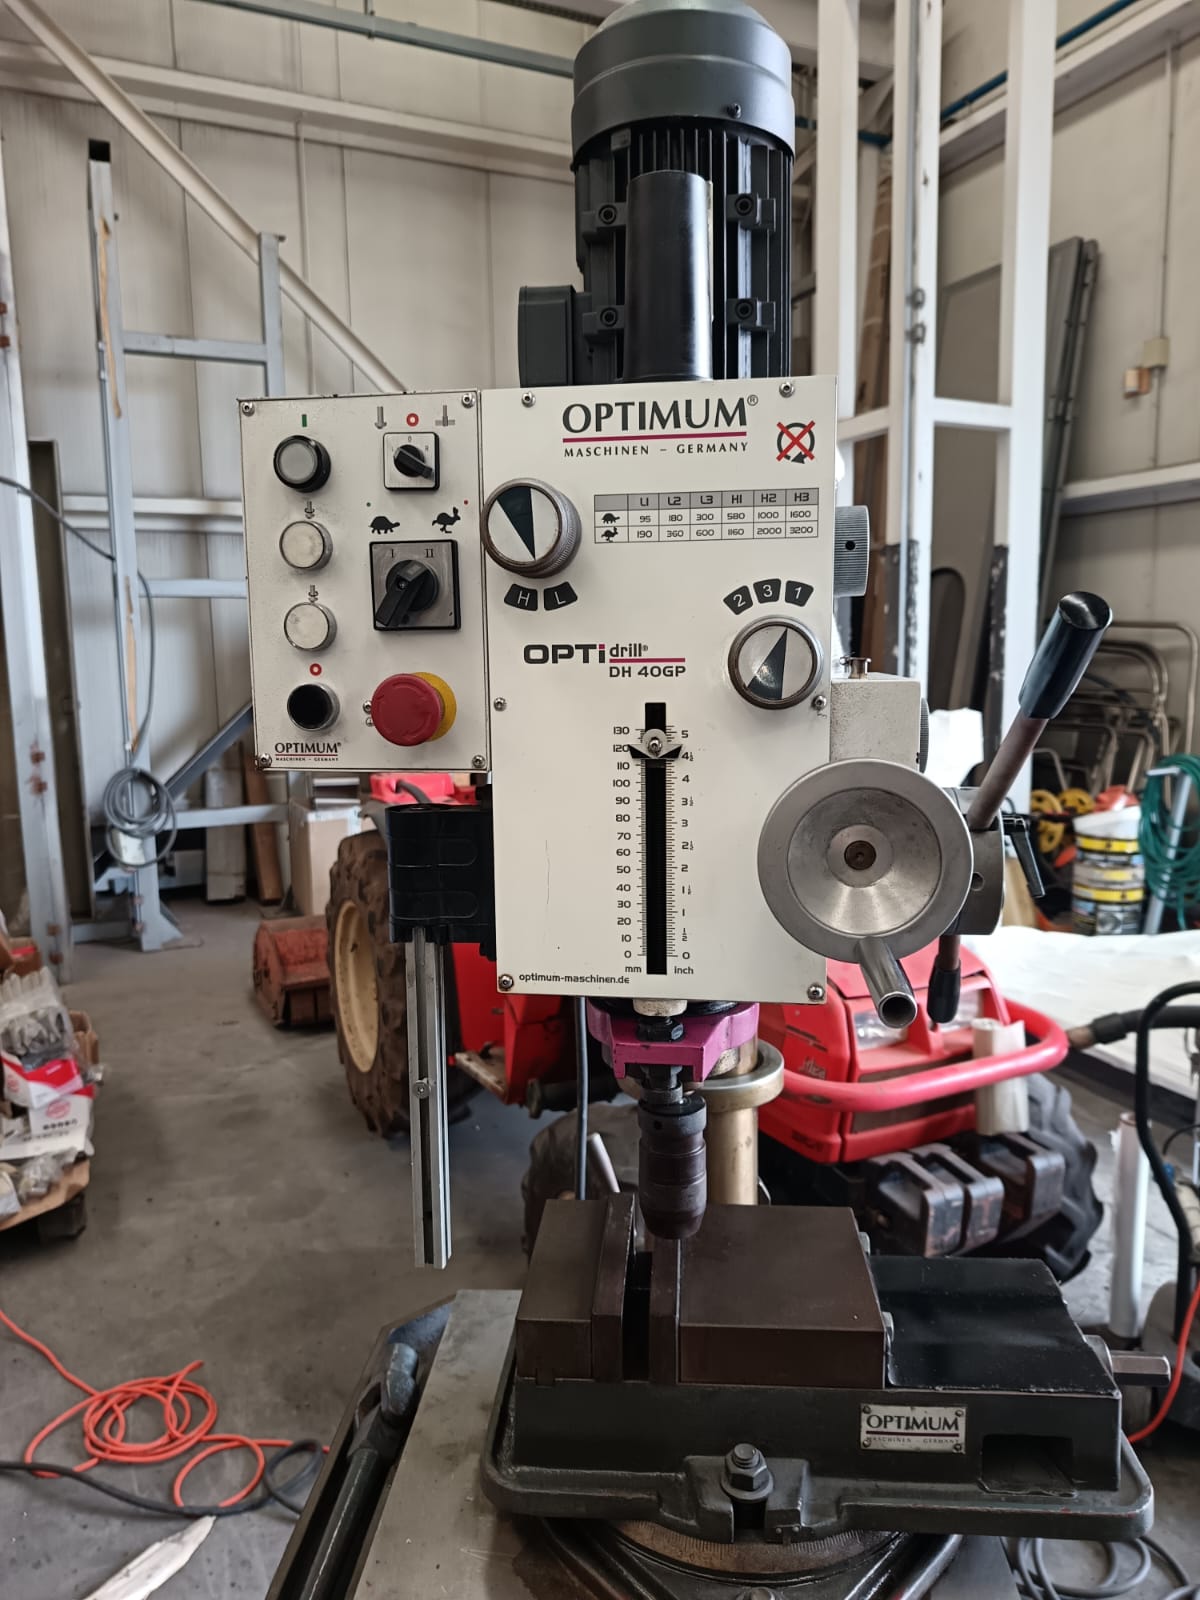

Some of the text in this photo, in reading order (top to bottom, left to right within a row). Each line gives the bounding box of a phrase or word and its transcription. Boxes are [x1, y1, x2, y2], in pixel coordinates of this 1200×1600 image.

[564, 445, 649, 457] MASCHINEN
[676, 441, 748, 454] GERMANY
[639, 492, 810, 507] L1 L2 L3 H1 H2 H3
[639, 510, 812, 523] 95 180 300 580 1000 1600
[636, 526, 813, 538] 190 360 600 1160 2000 3200
[517, 590, 566, 606] H L
[733, 584, 802, 607] 2 3 1
[609, 665, 686, 677] DH 40GP
[613, 726, 630, 735] 130
[681, 730, 689, 739] 5
[617, 762, 630, 770] 110
[612, 779, 631, 787] 100
[682, 775, 690, 783] 4
[615, 797, 631, 805] 90
[615, 814, 631, 822] 80
[681, 819, 688, 827] 3
[617, 832, 631, 840] 70
[616, 848, 631, 856] 60
[616, 865, 631, 874] 50
[681, 864, 688, 872] 2
[616, 884, 631, 892] 40
[617, 900, 631, 909] 30
[617, 917, 632, 925] 20
[621, 934, 632, 943] 10
[624, 950, 632, 959] 0
[682, 951, 690, 960] 0
[674, 966, 694, 975] inch
[519, 973, 630, 984] optimum-maschinen.de
[866, 1414, 959, 1430] OPTIMUM
